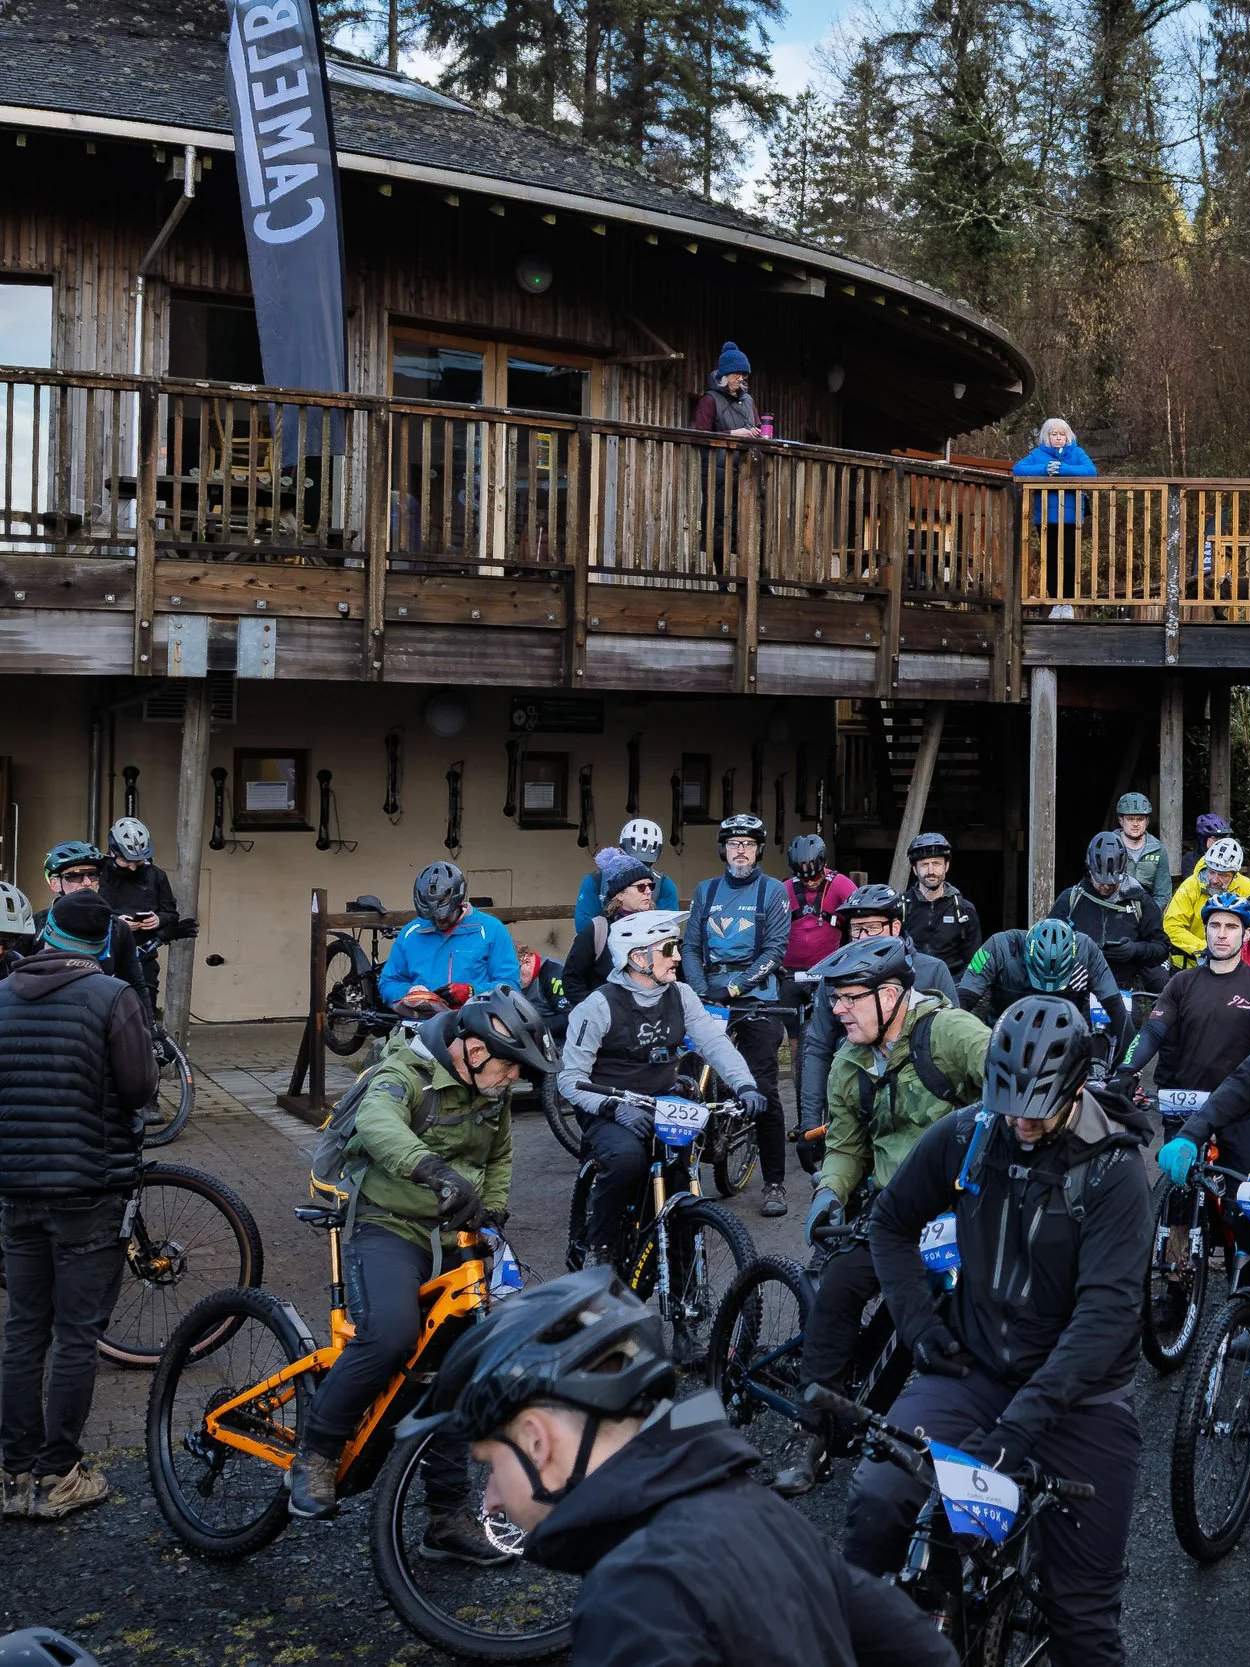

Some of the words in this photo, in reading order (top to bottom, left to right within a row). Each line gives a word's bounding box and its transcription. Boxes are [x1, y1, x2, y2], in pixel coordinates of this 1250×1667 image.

[1169, 1091, 1198, 1106] 193
[667, 1103, 699, 1121] 252
[924, 1250, 941, 1262] FOX
[631, 1241, 654, 1289] MAXXIS
[971, 1469, 989, 1493] 6
[983, 1508, 1001, 1522] FOX
